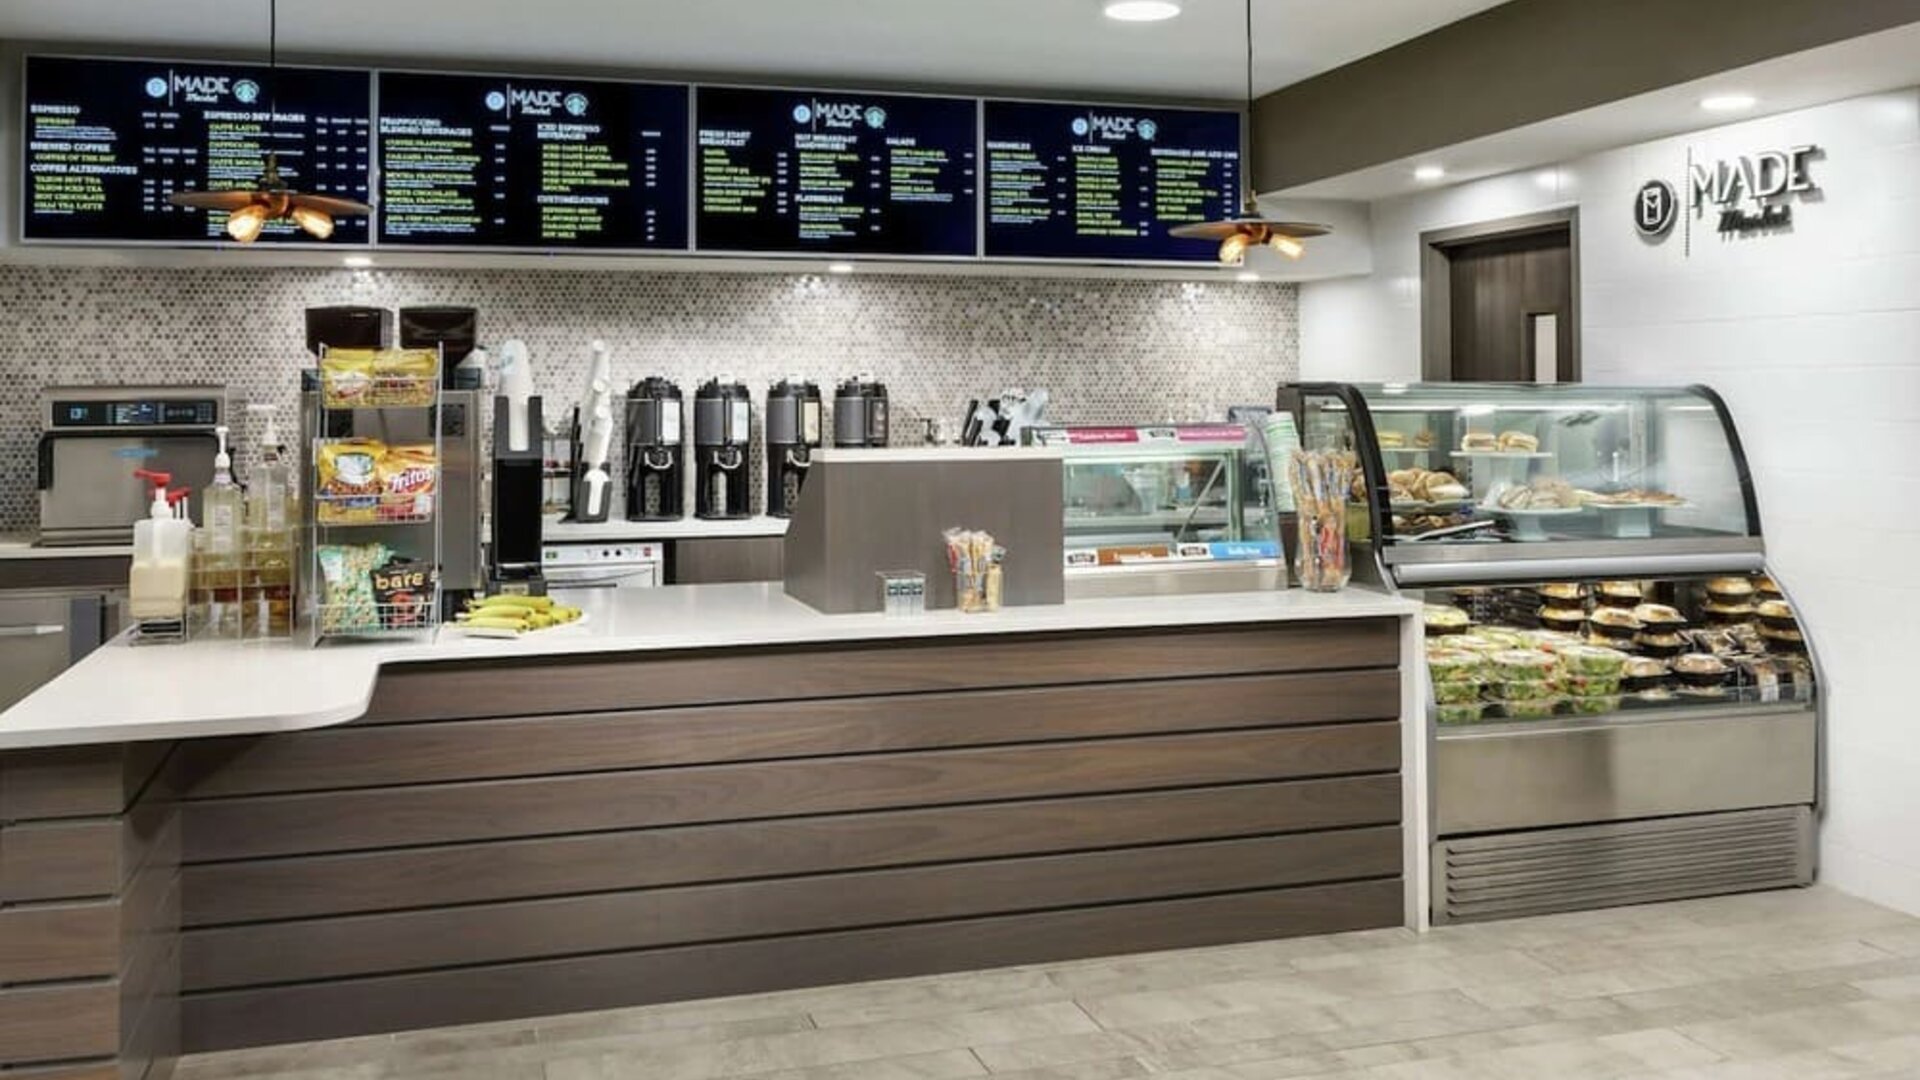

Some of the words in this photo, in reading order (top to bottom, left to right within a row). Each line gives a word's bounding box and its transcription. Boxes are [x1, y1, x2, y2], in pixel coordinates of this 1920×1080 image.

[174, 75, 230, 94] MADE
[512, 90, 562, 107] MADE
[31, 104, 81, 114] ESPRESSO
[817, 103, 862, 119] MADE
[1093, 116, 1134, 132] MADE
[74, 143, 111, 153] COFFEE
[31, 164, 67, 173] COFFEE
[69, 165, 138, 175] ALTERNATIVES
[1688, 145, 1818, 208] MADE
[389, 468, 433, 493] Fritos
[375, 572, 424, 590] bare
